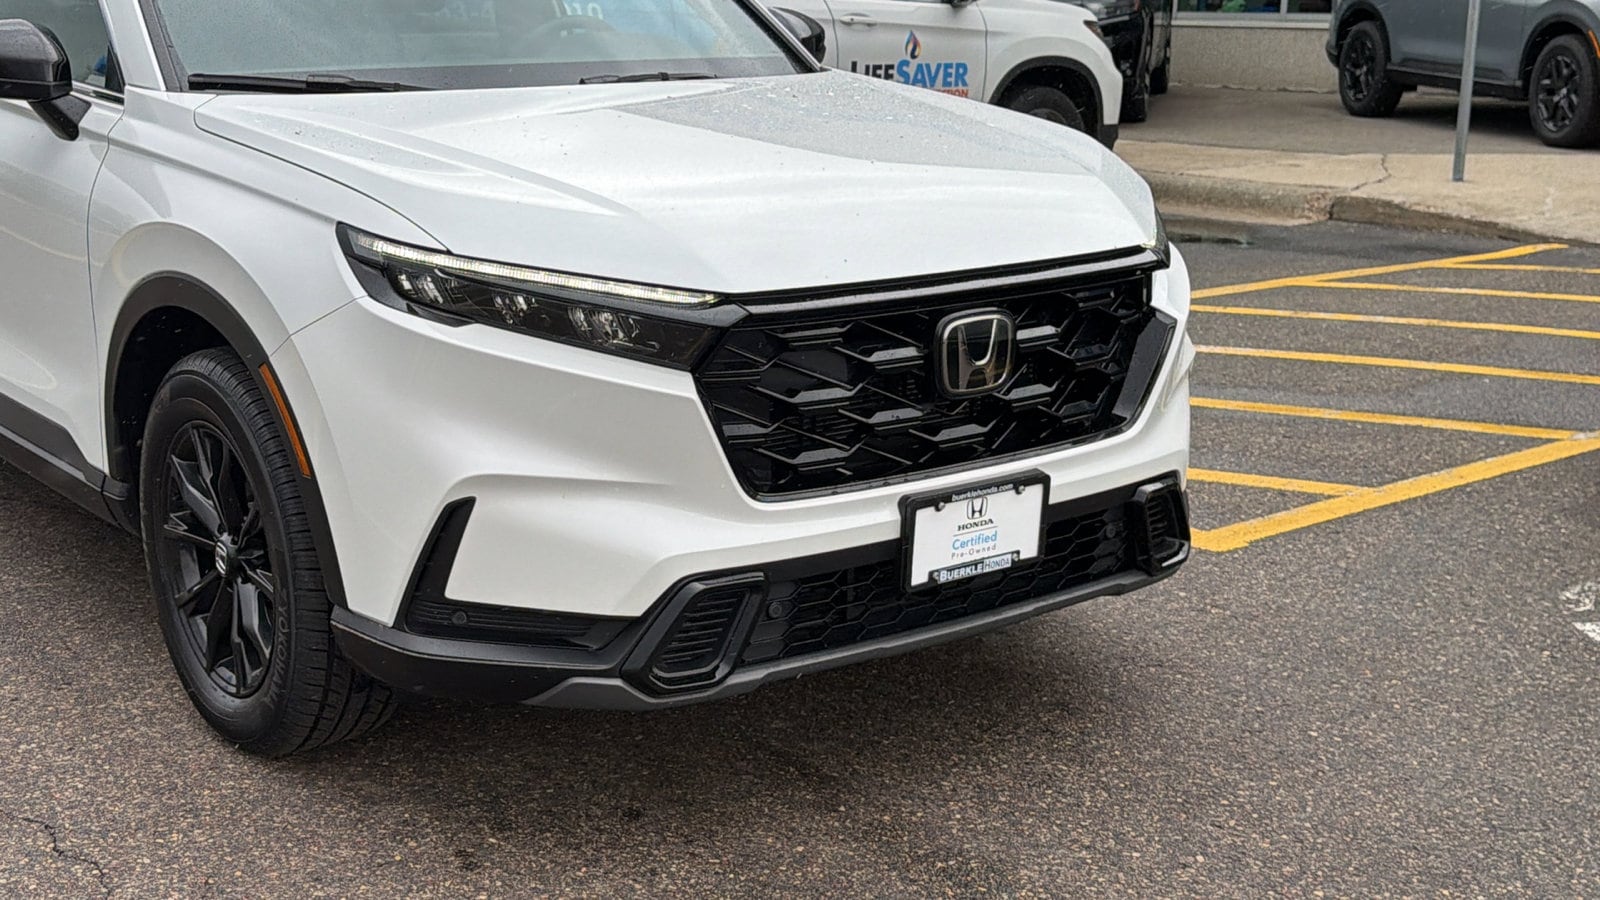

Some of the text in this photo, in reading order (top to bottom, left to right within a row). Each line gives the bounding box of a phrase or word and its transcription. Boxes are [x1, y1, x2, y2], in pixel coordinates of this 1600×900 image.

[952, 484, 1014, 502] buerklehonda.com
[957, 518, 994, 532] HONDA
[952, 531, 998, 551] Certified
[951, 544, 997, 560] Pre-Owned
